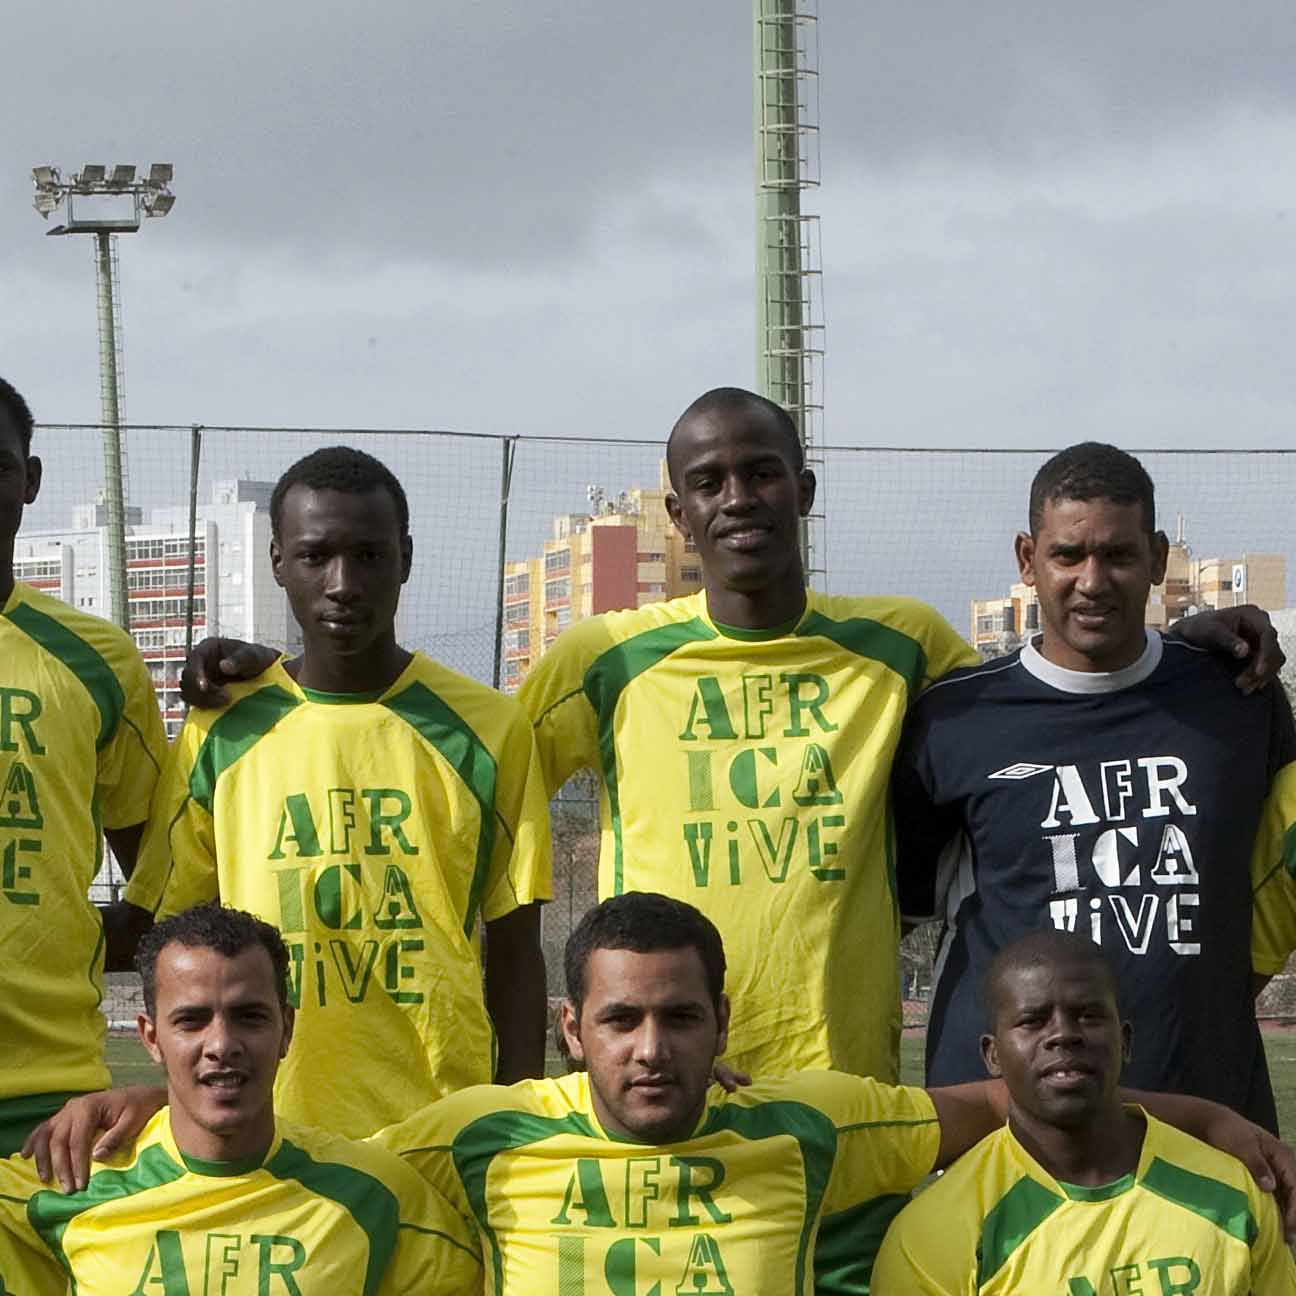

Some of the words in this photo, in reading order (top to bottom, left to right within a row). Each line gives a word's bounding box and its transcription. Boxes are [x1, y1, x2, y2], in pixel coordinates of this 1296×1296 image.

[679, 672, 838, 741] AFR
[686, 742, 843, 812] ICA
[1041, 756, 1197, 828] AFR
[267, 788, 419, 859] AFR
[1042, 824, 1199, 894] ICA
[268, 864, 423, 933] ICA
[550, 1155, 732, 1227] AFR
